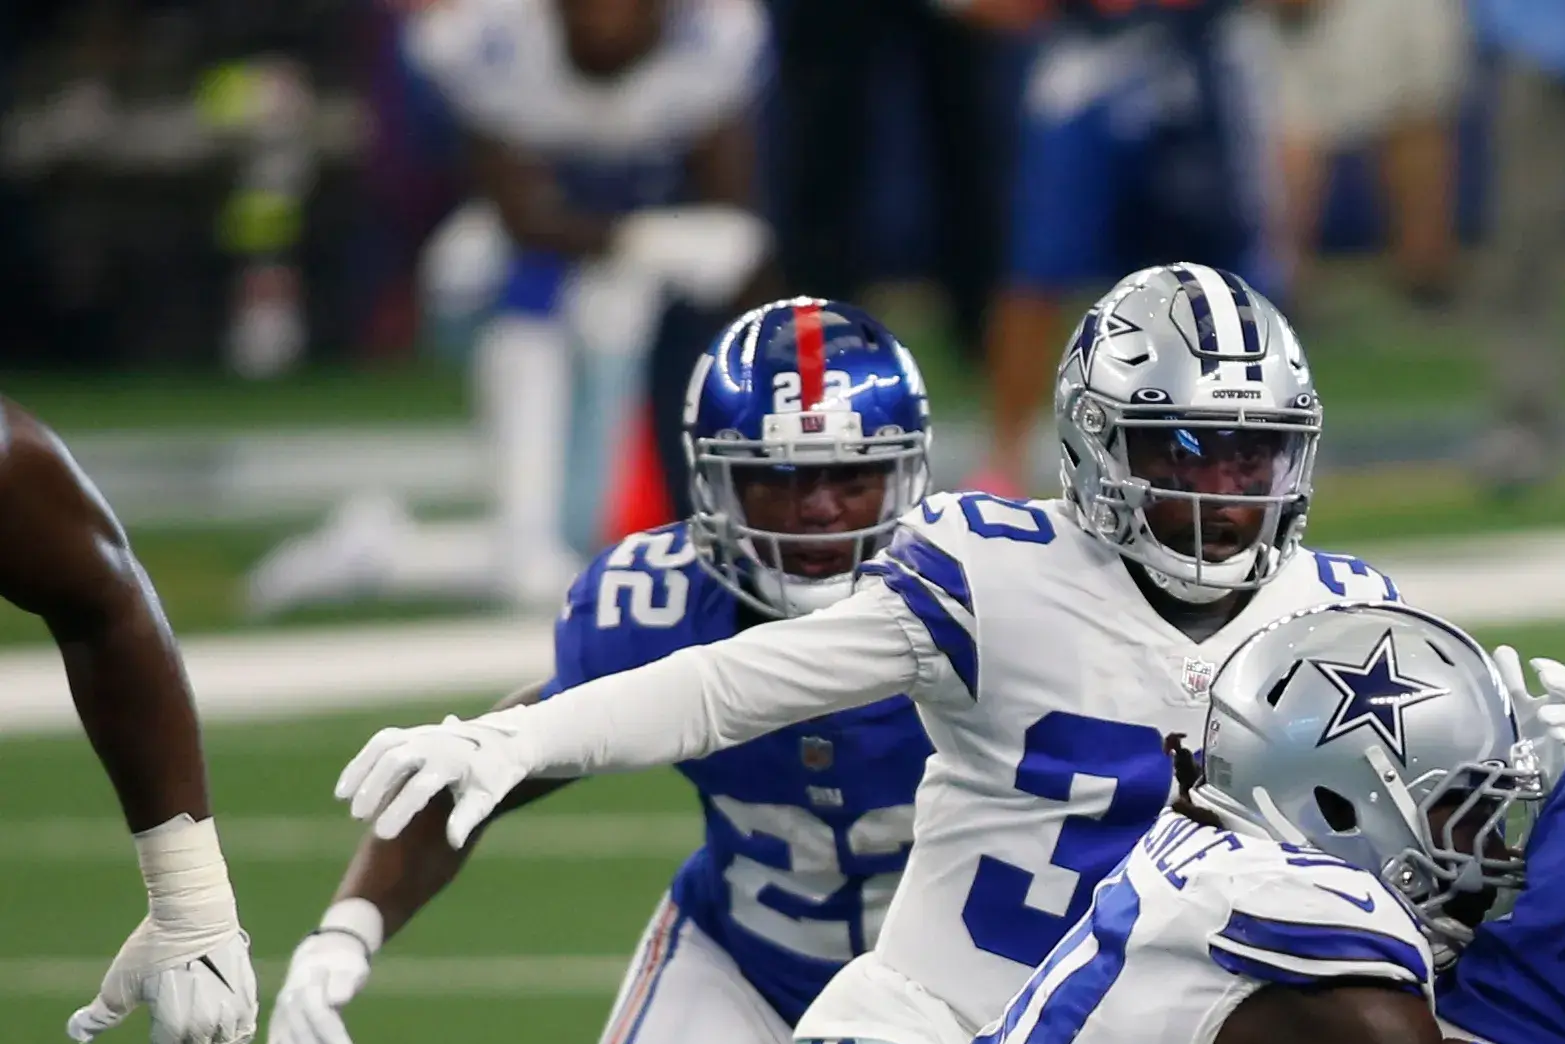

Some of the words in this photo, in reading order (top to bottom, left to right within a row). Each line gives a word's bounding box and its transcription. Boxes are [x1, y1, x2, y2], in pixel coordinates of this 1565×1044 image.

[773, 370, 852, 413] 22
[1212, 388, 1262, 399] COWBOYS
[597, 530, 697, 630] 22
[961, 710, 1175, 969] 3
